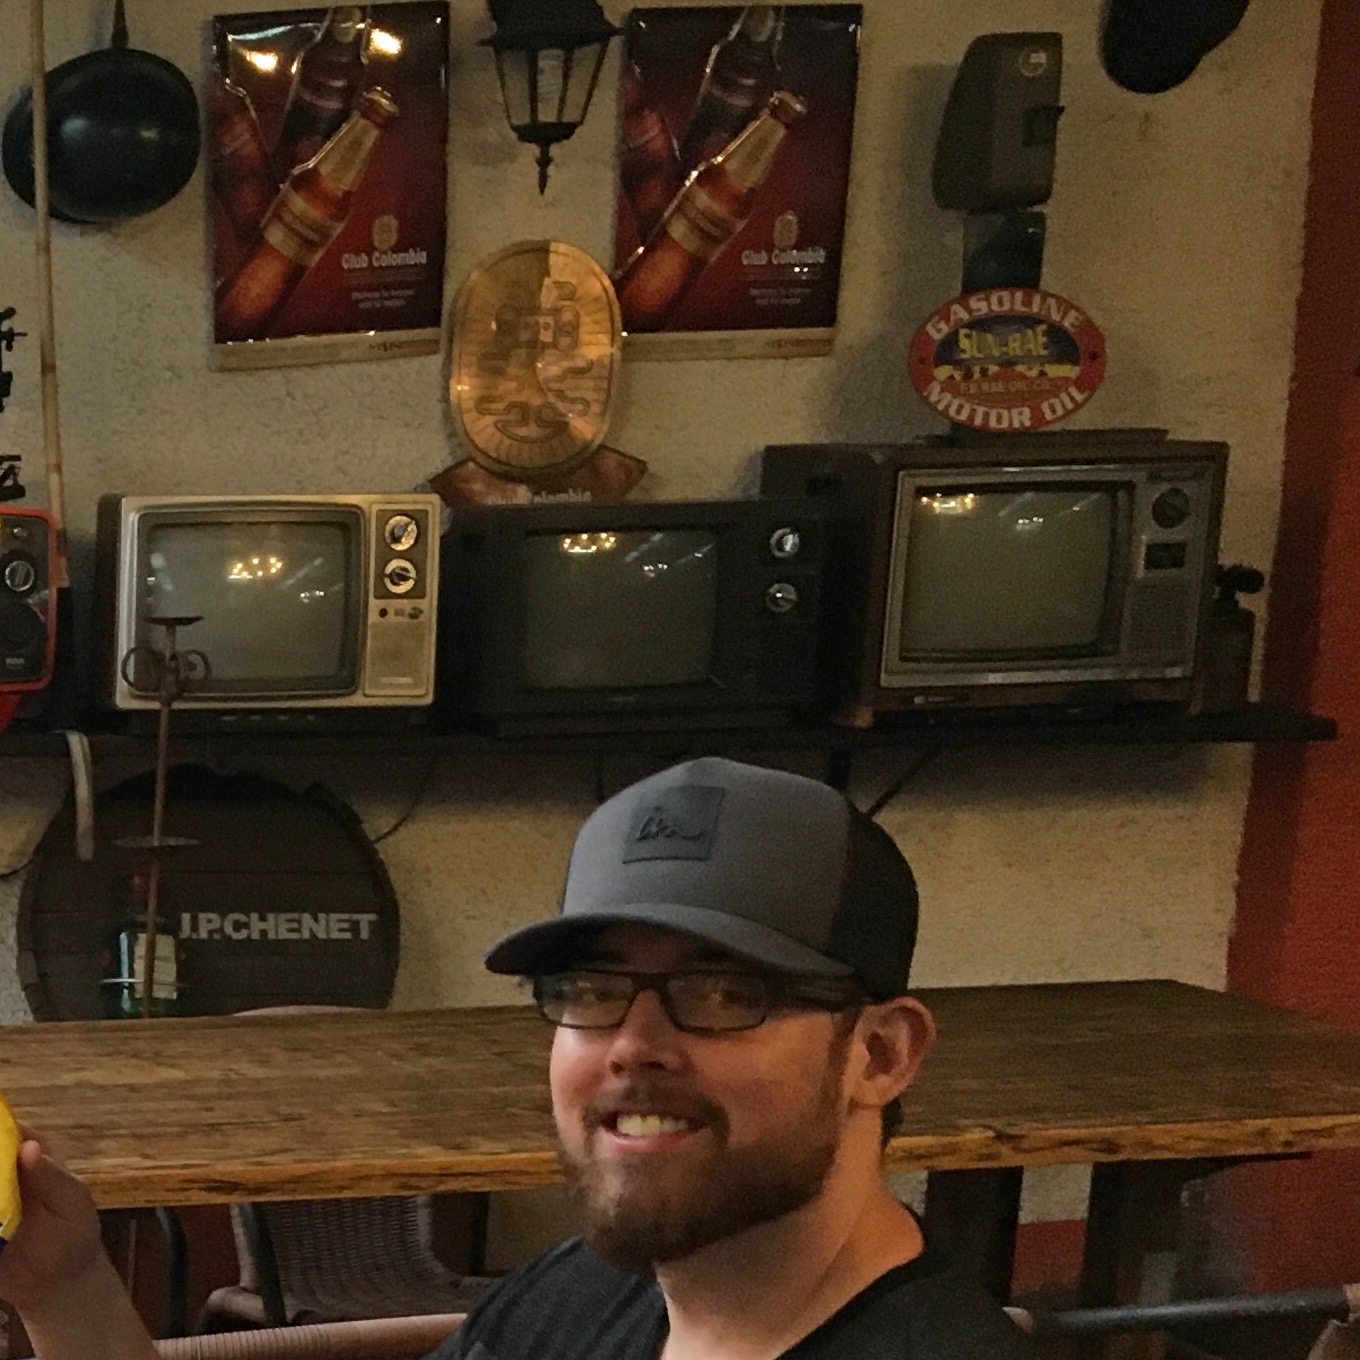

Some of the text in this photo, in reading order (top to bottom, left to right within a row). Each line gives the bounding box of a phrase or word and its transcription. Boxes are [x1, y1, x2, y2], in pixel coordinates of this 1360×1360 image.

[341, 248, 428, 269] Club Colombia
[925, 290, 1084, 341] GASOLINE
[923, 381, 1090, 429] MOTOR OIL
